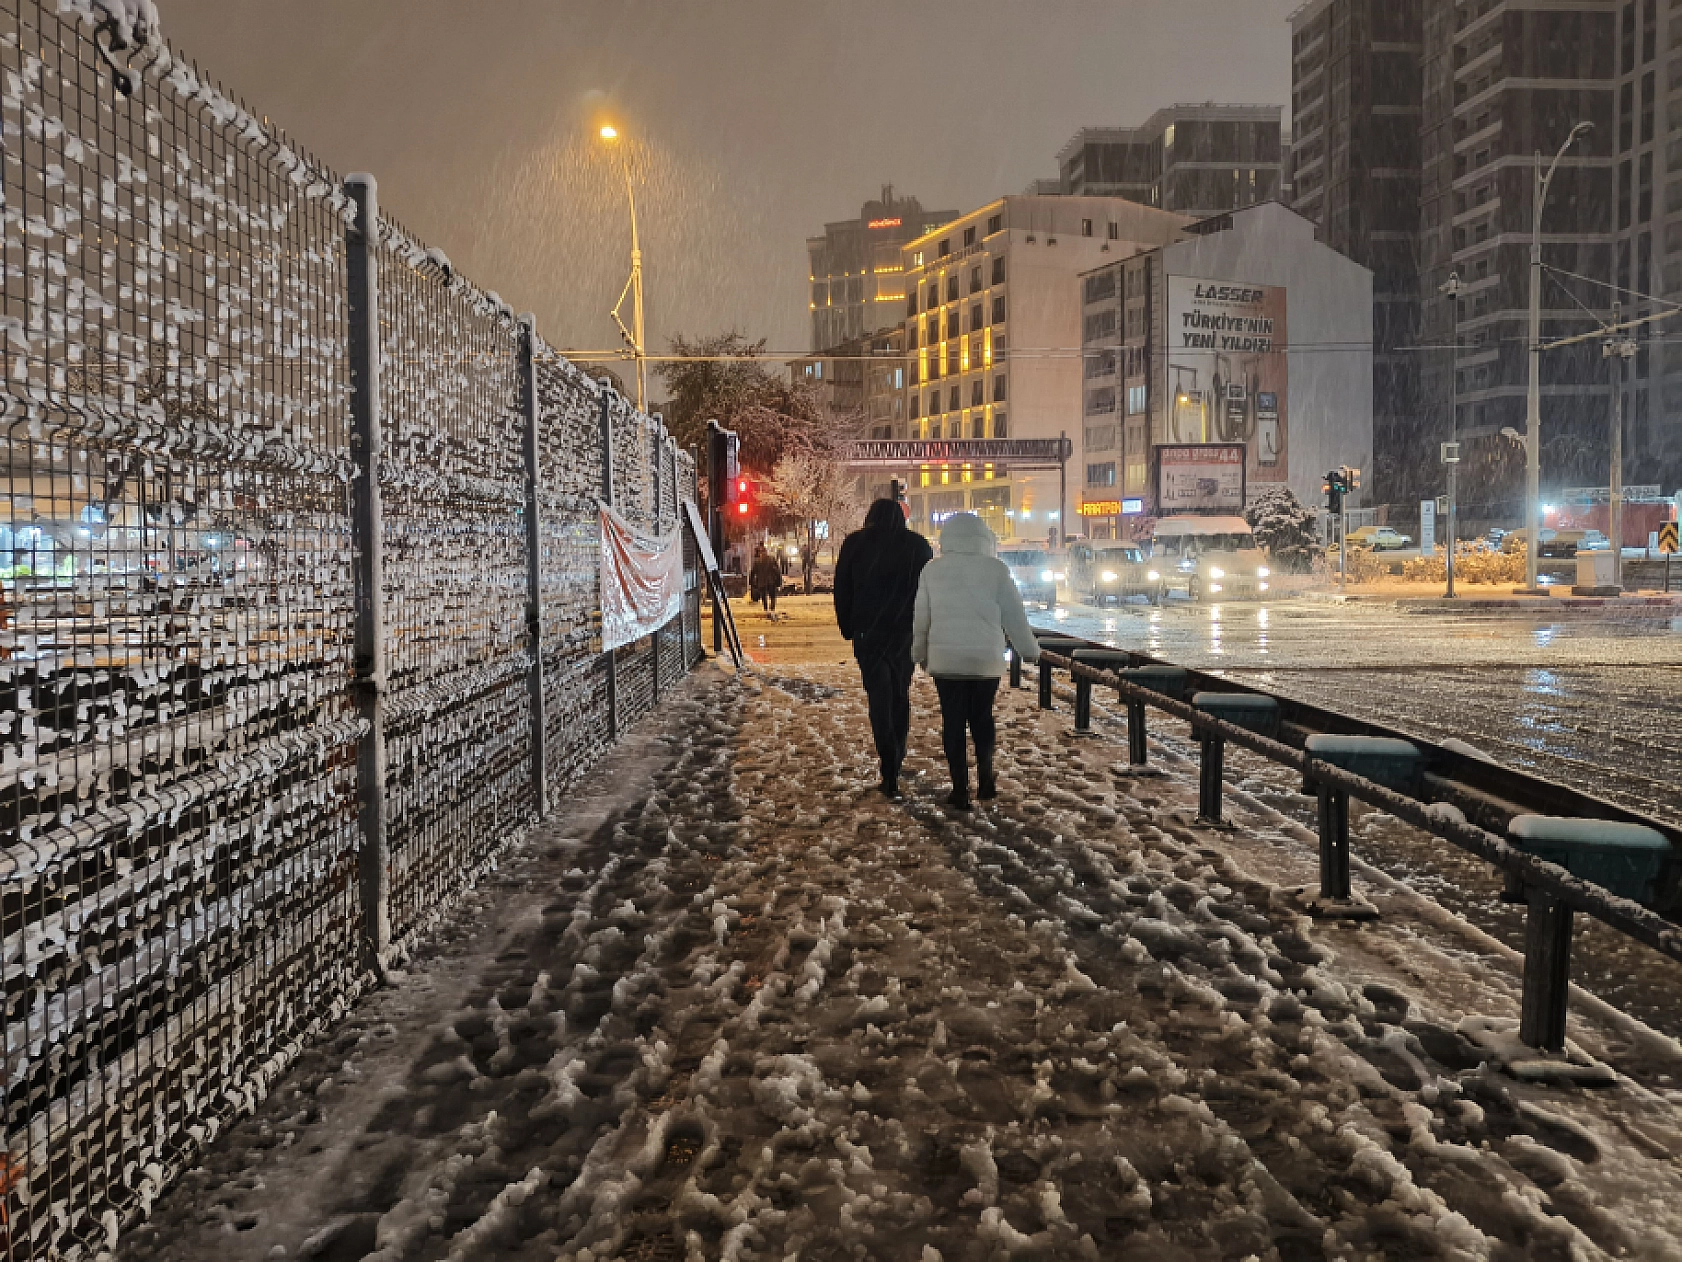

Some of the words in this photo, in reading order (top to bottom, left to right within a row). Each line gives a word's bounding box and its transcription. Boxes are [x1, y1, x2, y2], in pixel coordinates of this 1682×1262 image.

[1193, 283, 1264, 302] LASSER
[1182, 308, 1273, 334] TÜRKİYE'NİN
[1182, 330, 1217, 348] YENİ
[1221, 335, 1271, 352] YILDIZI
[1219, 447, 1239, 462] 44
